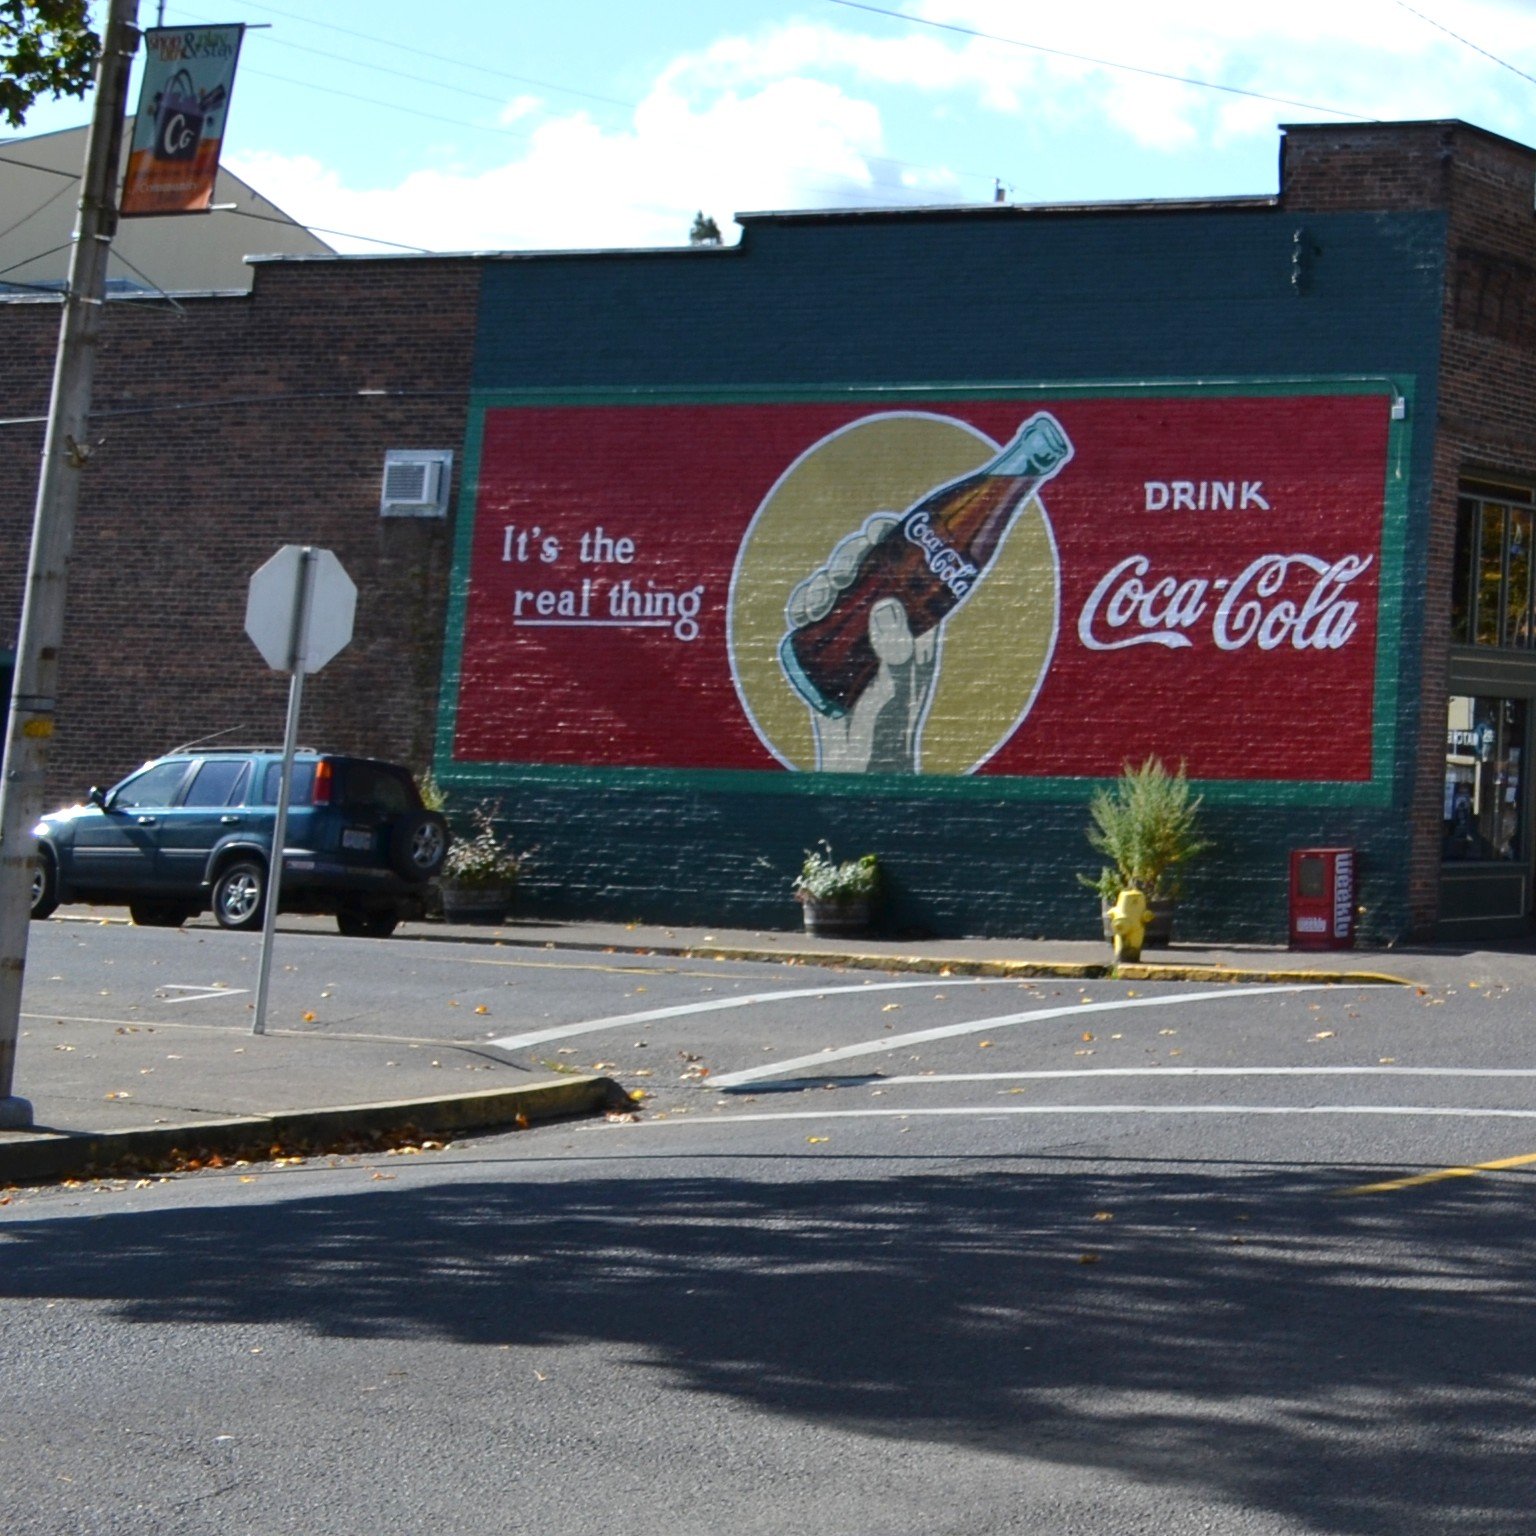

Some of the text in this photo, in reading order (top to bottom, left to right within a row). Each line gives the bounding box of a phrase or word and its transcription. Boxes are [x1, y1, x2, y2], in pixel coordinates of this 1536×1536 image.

[1144, 481, 1270, 511] DRINK
[502, 525, 635, 564] It's the
[513, 578, 705, 642] real thing
[1077, 553, 1374, 651] Coca-Cola
